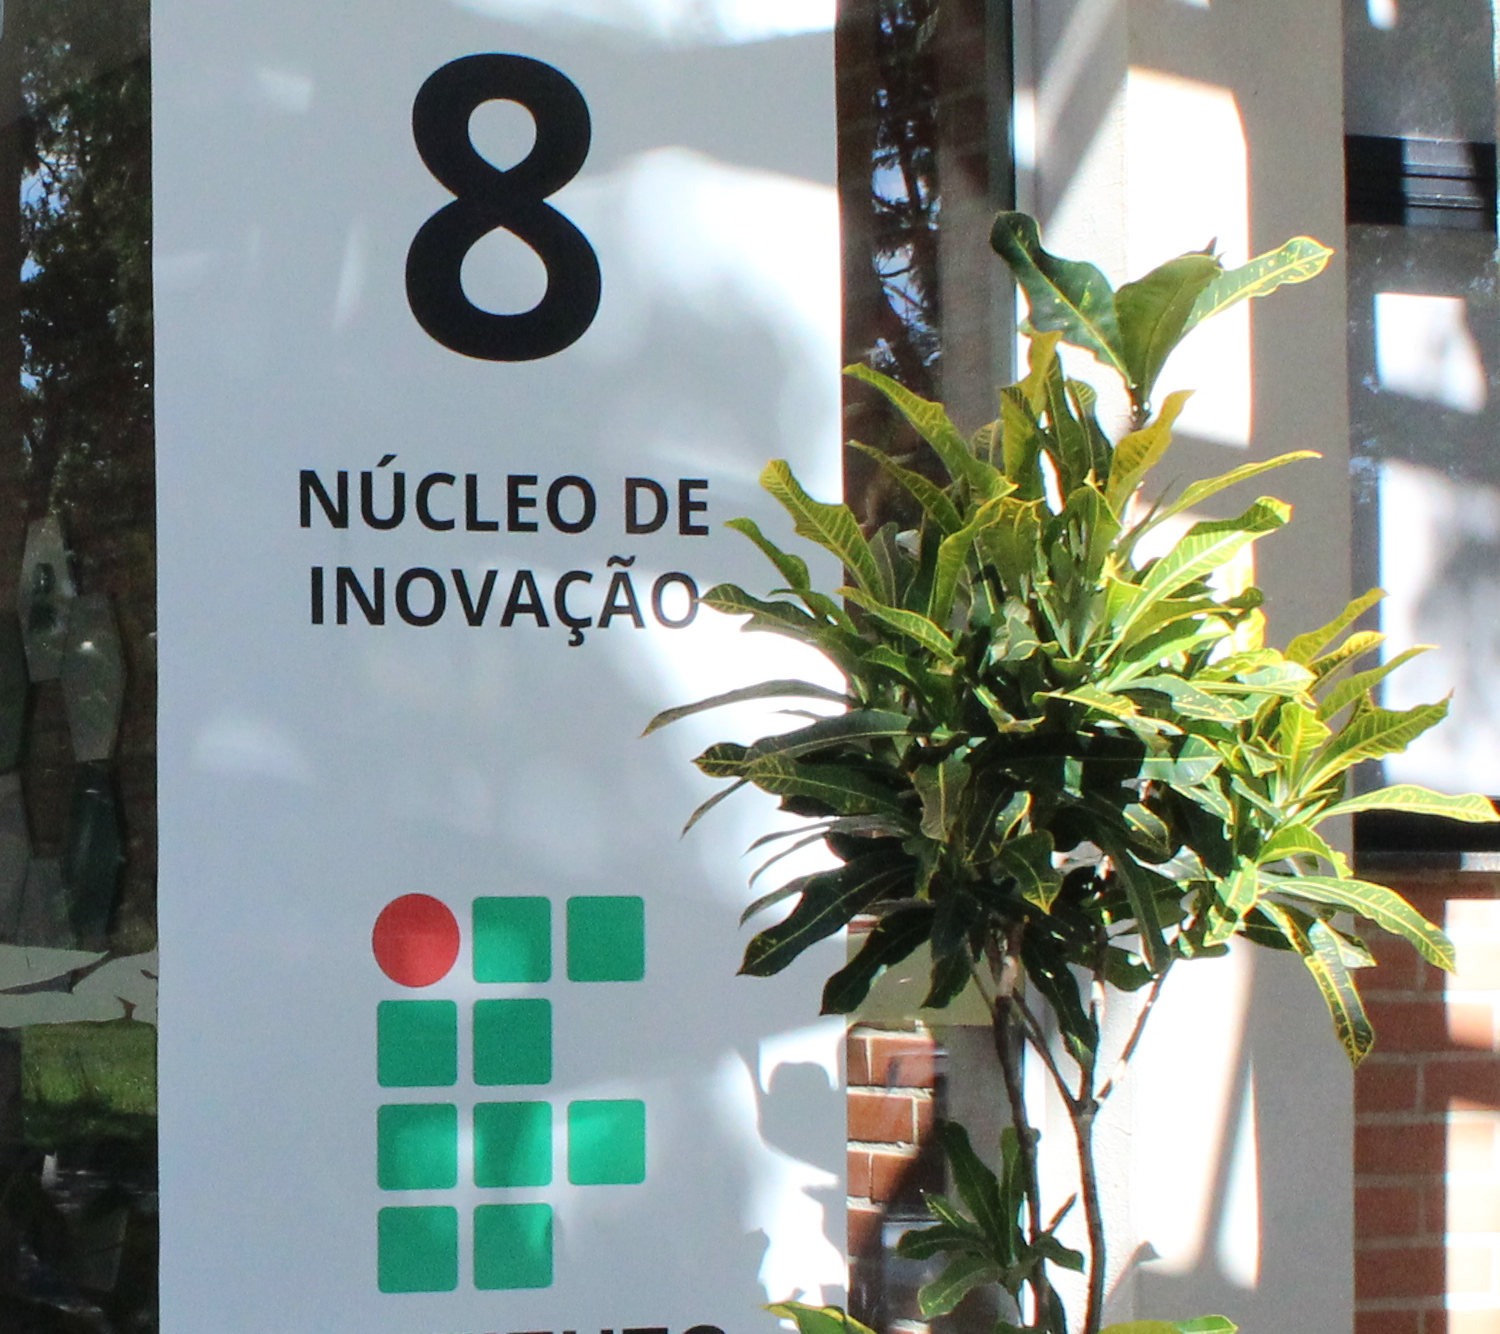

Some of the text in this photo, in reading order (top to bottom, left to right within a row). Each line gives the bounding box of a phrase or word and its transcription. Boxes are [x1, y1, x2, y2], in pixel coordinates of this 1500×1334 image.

[406, 54, 601, 361] 8
[300, 455, 708, 535] NÚCLEO DE
[312, 556, 697, 646] INOVAÇÃO
